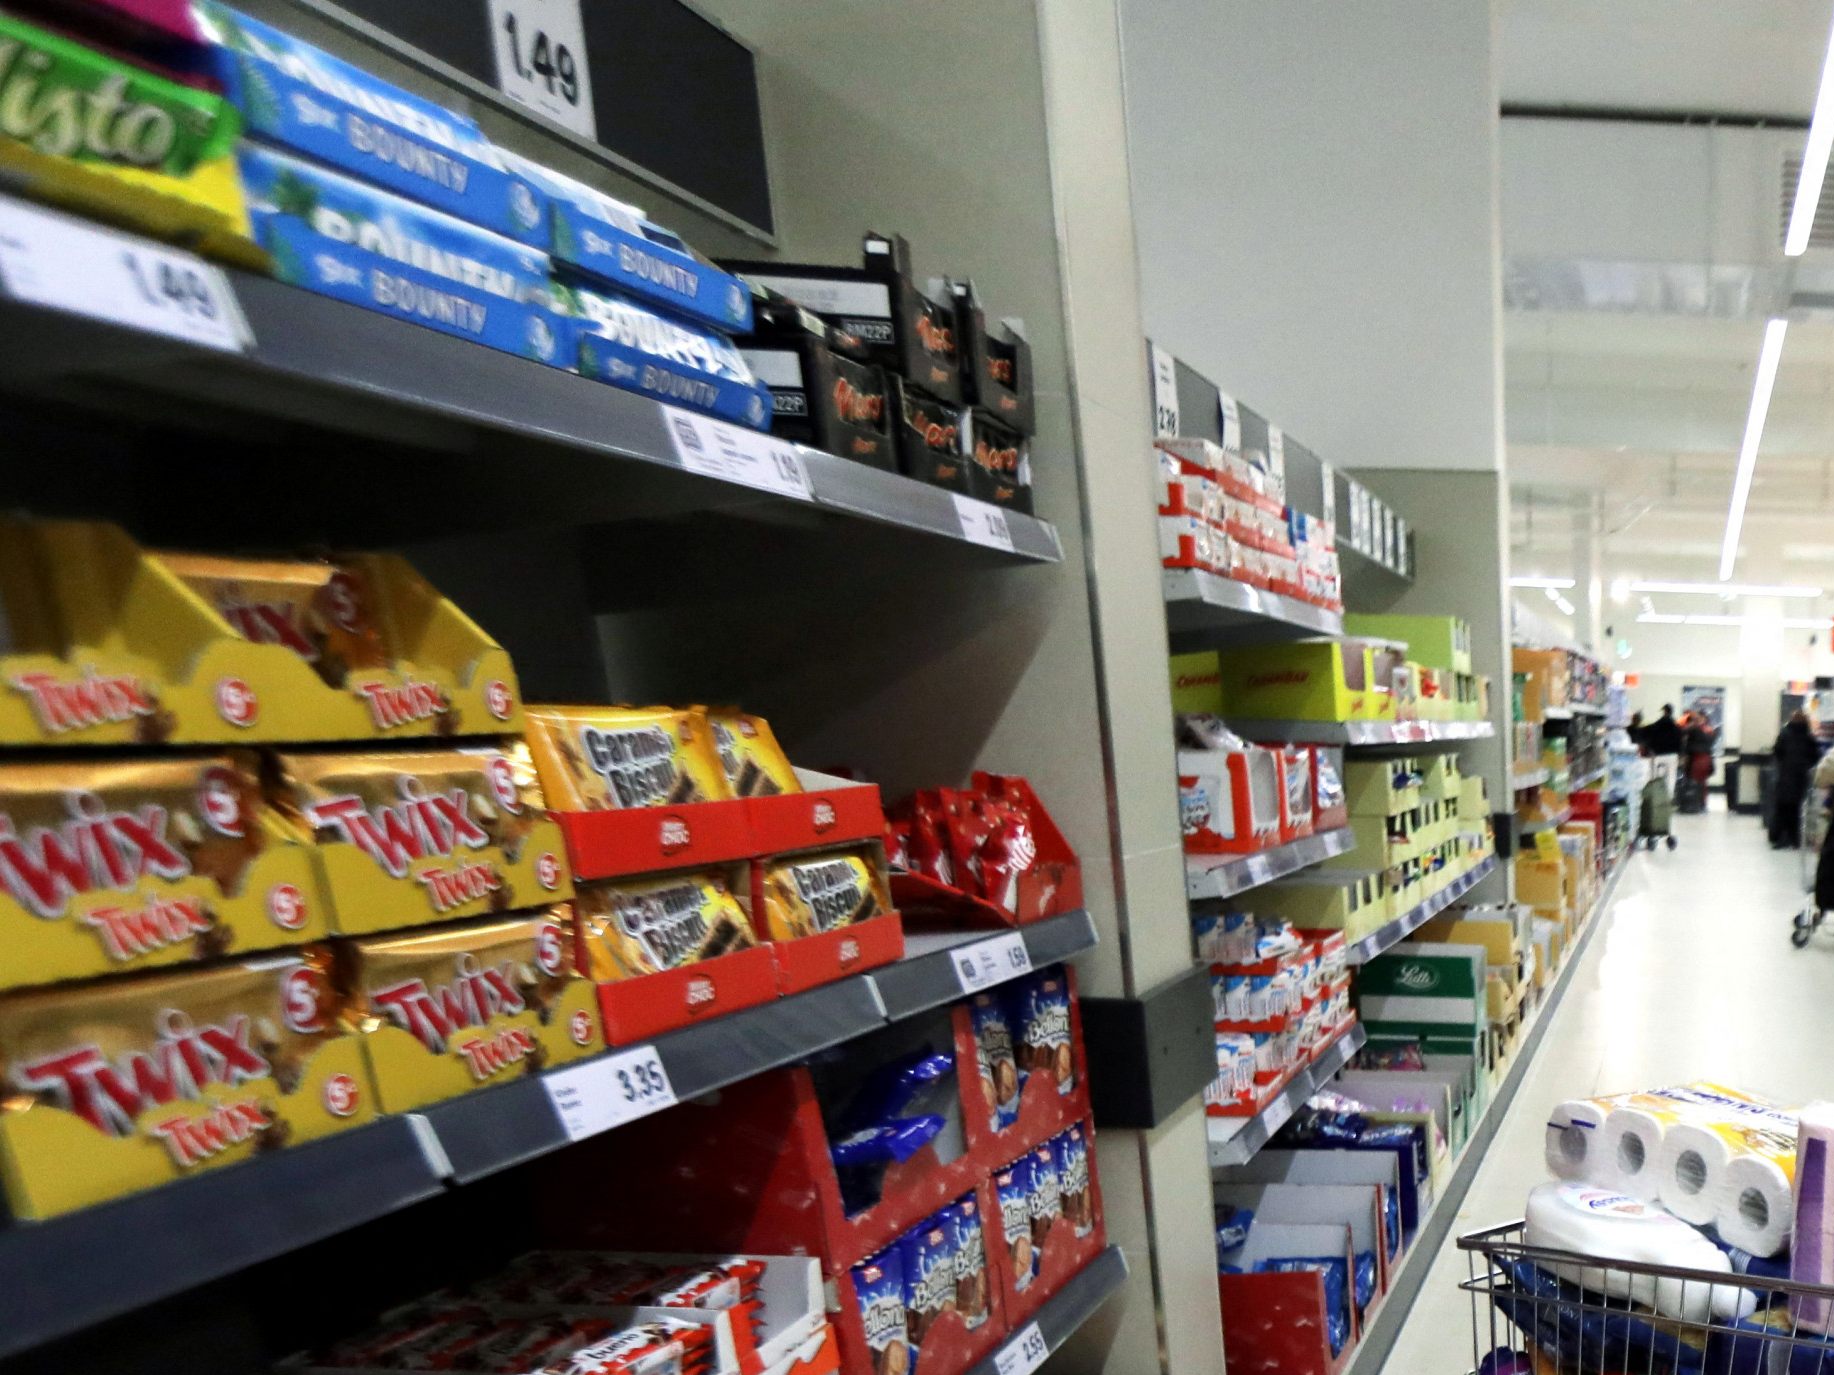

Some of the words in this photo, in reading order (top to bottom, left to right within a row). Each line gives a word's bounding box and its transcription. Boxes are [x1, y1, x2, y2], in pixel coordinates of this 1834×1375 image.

[505, 12, 577, 105] 1.49
[347, 113, 469, 193] BOUNTY
[618, 242, 699, 298] BOUNTY
[371, 267, 487, 336] BOUNTY
[640, 363, 720, 409] BOUNTY
[617, 1060, 665, 1102] 3.35
[586, 1332, 639, 1361] bueno
